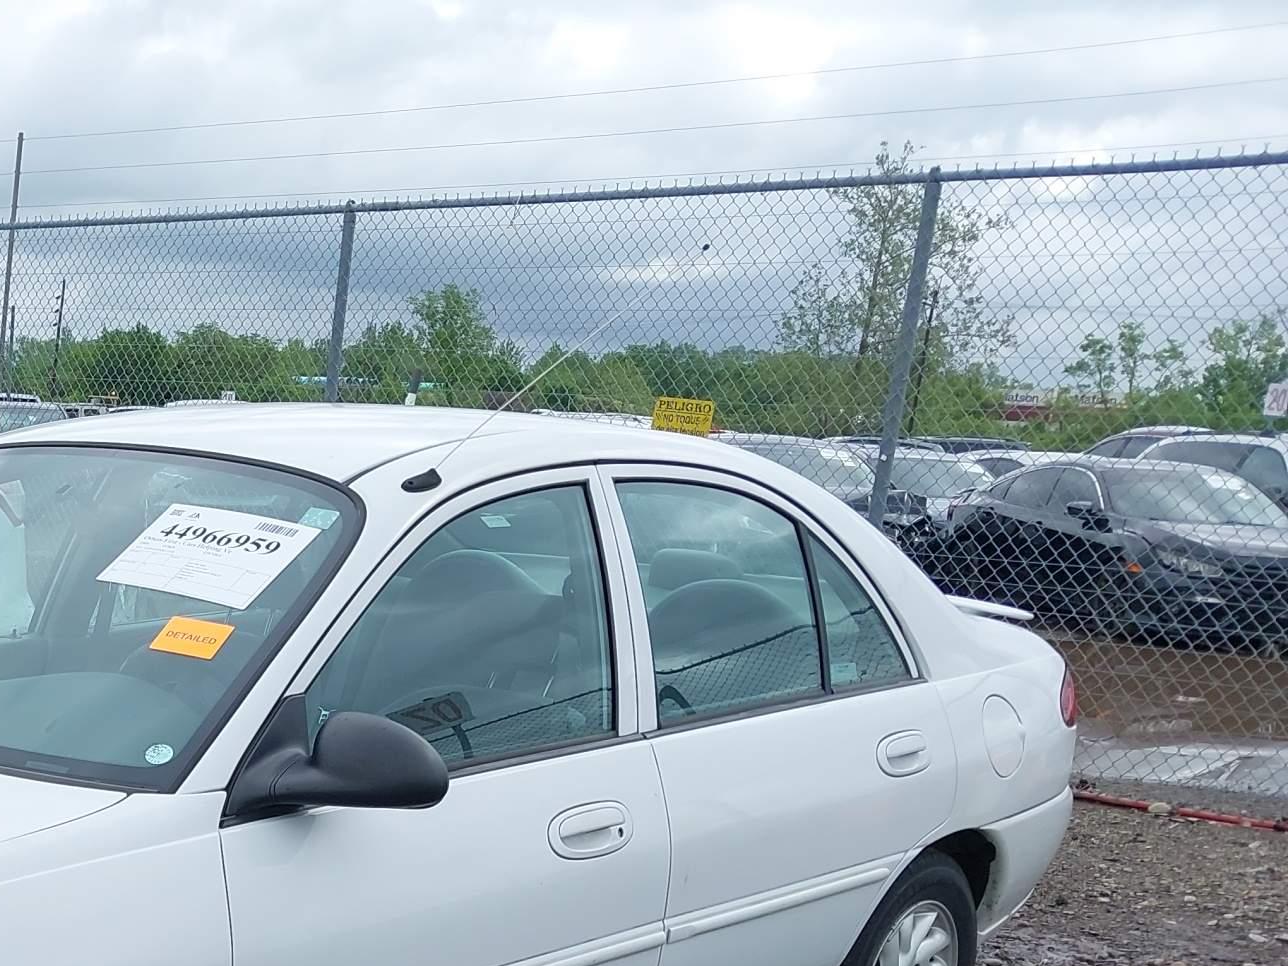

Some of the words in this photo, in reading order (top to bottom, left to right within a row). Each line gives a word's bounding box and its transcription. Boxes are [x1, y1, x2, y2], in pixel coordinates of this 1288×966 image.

[658, 400, 712, 414] PELIGRO
[663, 413, 674, 423] NO
[675, 414, 702, 425] TOQUE
[159, 523, 281, 555] 44966959
[166, 630, 217, 645] DETAILED
